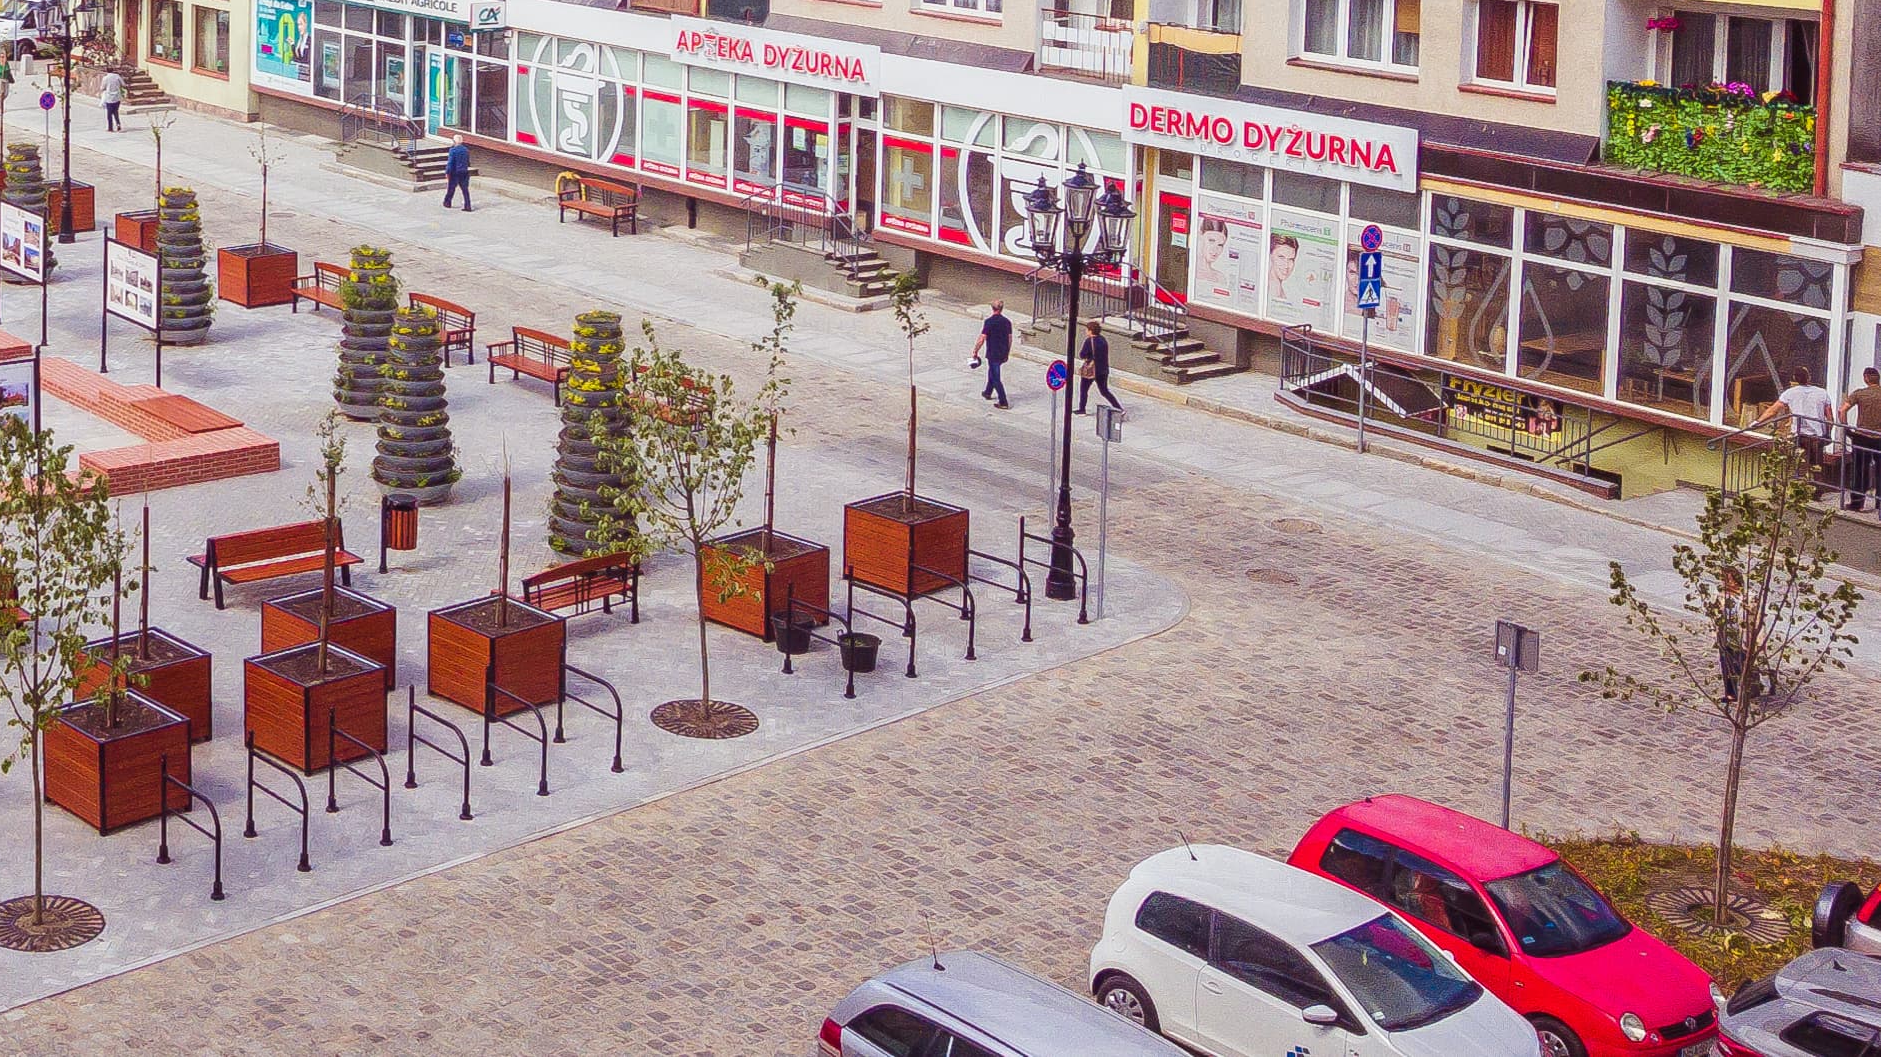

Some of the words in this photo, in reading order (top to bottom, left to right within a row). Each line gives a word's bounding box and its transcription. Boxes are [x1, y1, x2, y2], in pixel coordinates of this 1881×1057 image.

[676, 29, 754, 63] APTEKA
[764, 44, 866, 82] DYŻURNA
[1130, 102, 1234, 144] DERMO
[1243, 121, 1397, 173] DYŻURNA
